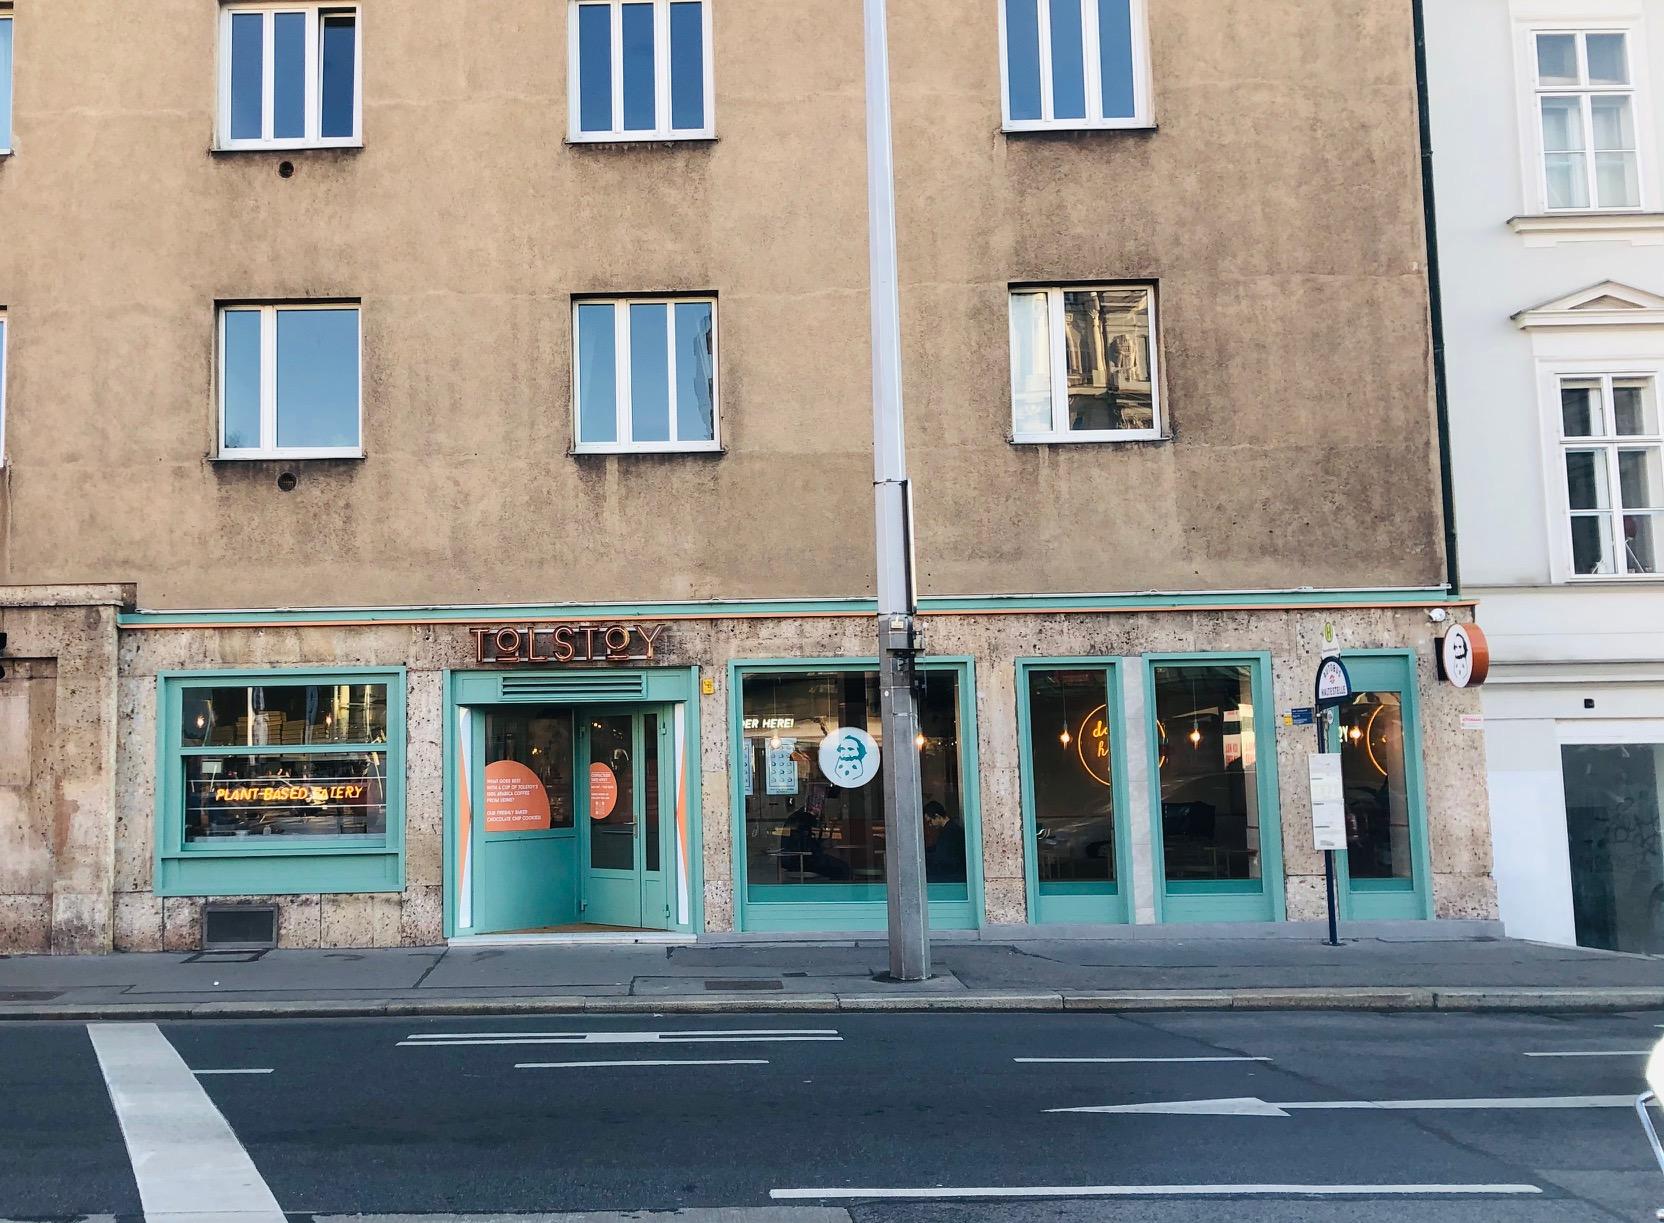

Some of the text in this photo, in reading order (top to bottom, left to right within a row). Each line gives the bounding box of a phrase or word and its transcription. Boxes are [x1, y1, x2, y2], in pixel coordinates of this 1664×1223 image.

[469, 624, 665, 662] TOLSTOY
[1321, 685, 1346, 697] HALTESTELLE
[762, 718, 795, 728] HERE!
[215, 786, 308, 801] PLANT-BASED
